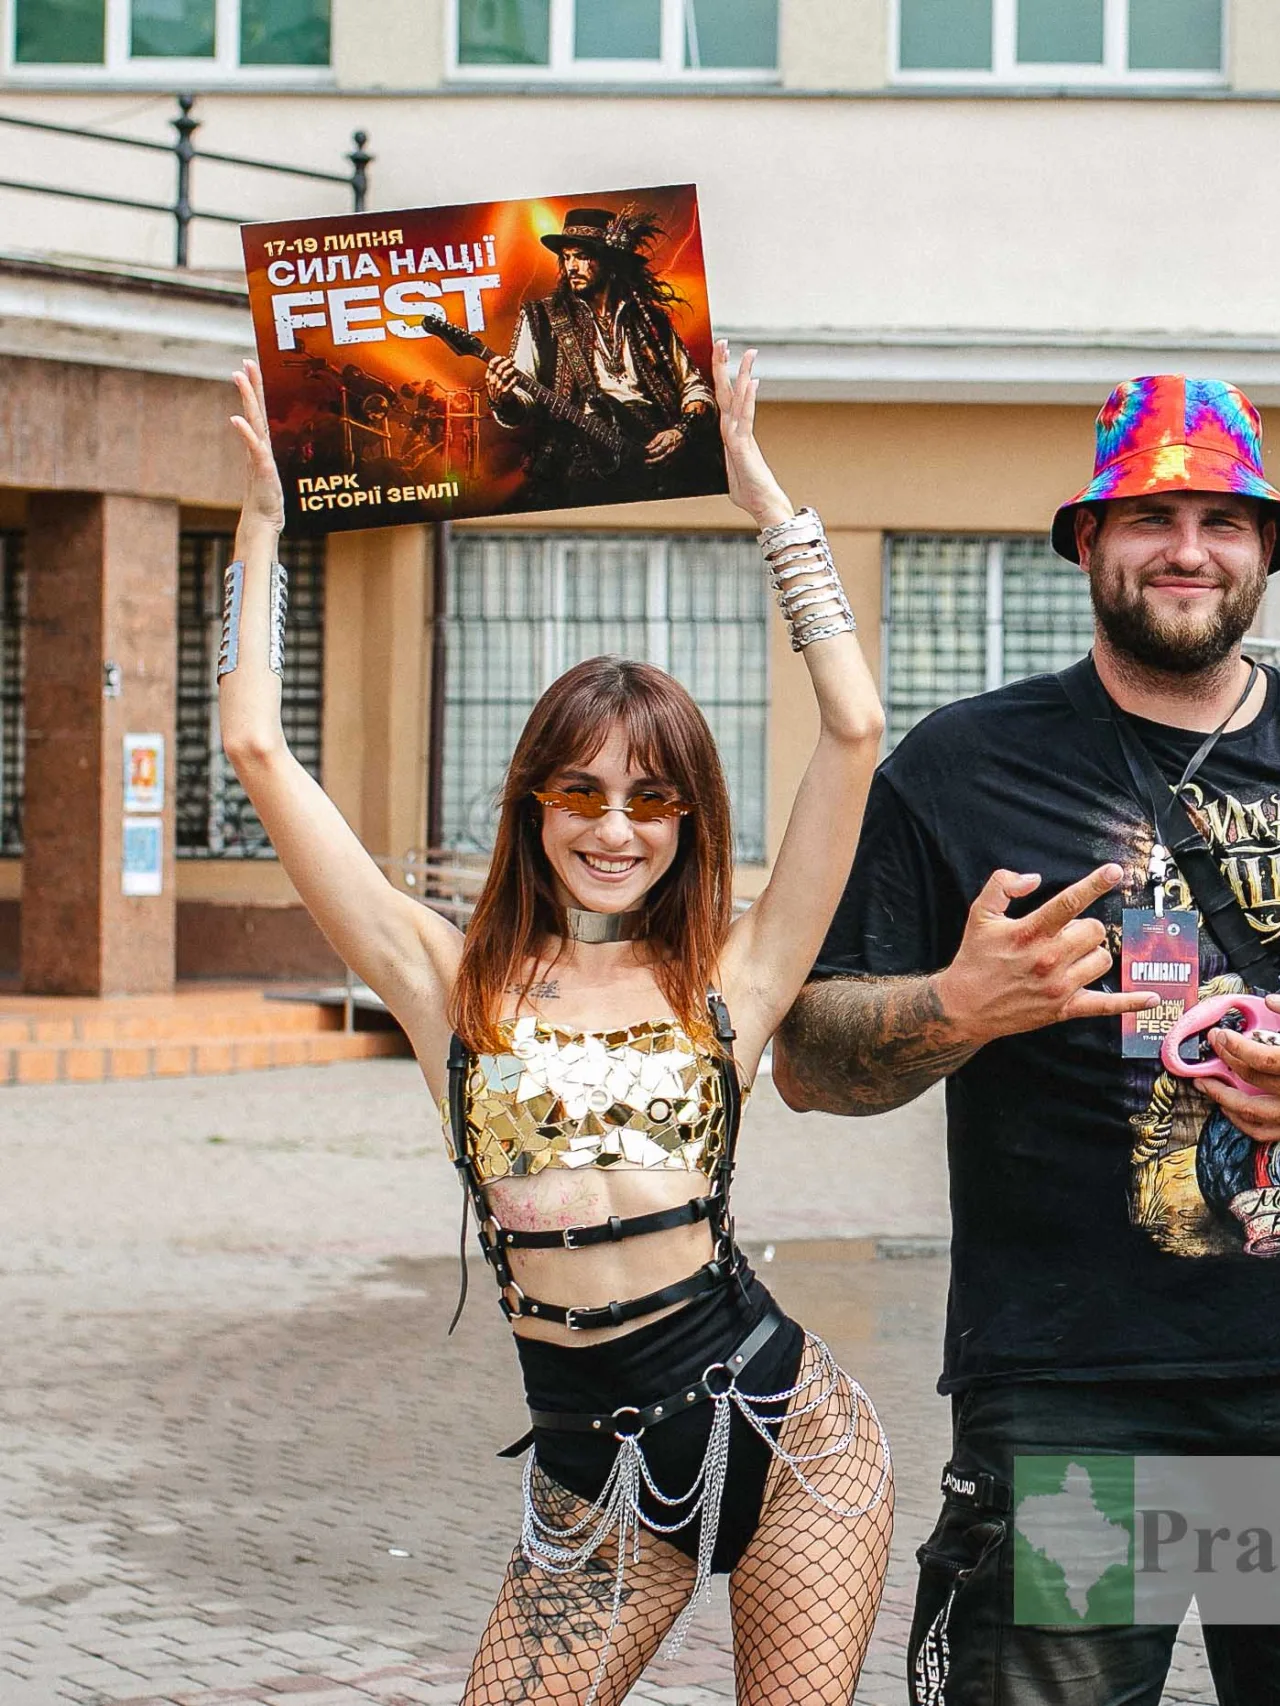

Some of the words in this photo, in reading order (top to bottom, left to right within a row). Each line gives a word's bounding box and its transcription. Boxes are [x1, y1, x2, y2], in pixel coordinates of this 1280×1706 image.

[264, 235, 318, 257] 17-19
[323, 229, 404, 253] ЛИПНЯ
[267, 253, 383, 287] СИЛА
[390, 235, 497, 276] НАЦІЇ
[270, 274, 502, 351] FEST
[297, 473, 360, 493] ПАРК
[299, 488, 383, 512] ІСТОРІЇ
[387, 482, 460, 503] ЗЕМЛІ
[1136, 1020, 1176, 1034] FES
